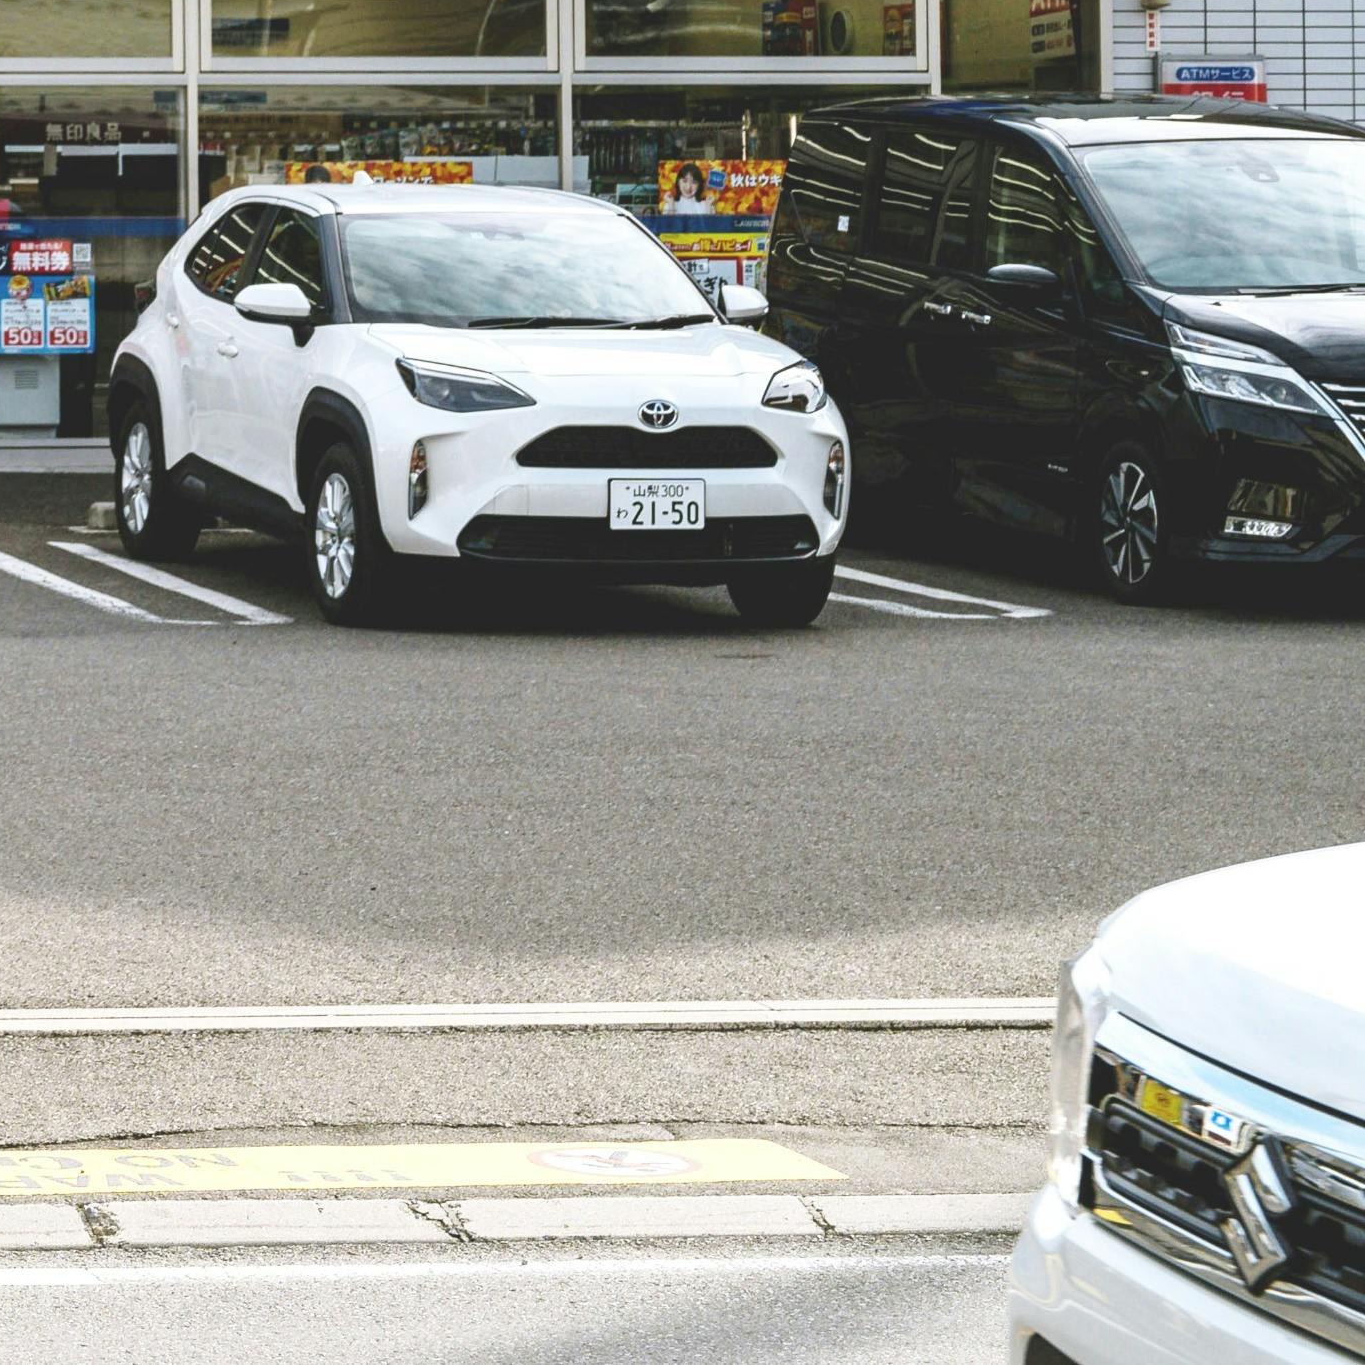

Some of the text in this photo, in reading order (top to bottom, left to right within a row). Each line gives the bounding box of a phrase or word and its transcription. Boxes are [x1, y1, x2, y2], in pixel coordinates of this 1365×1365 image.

[1180, 68, 1252, 80] ATMサービス
[45, 122, 122, 141] 無印良品
[12, 251, 70, 272] 無料券
[633, 484, 684, 497] 山梨 300
[616, 500, 699, 525] わ 21-50
[113, 1152, 240, 1169] NO
